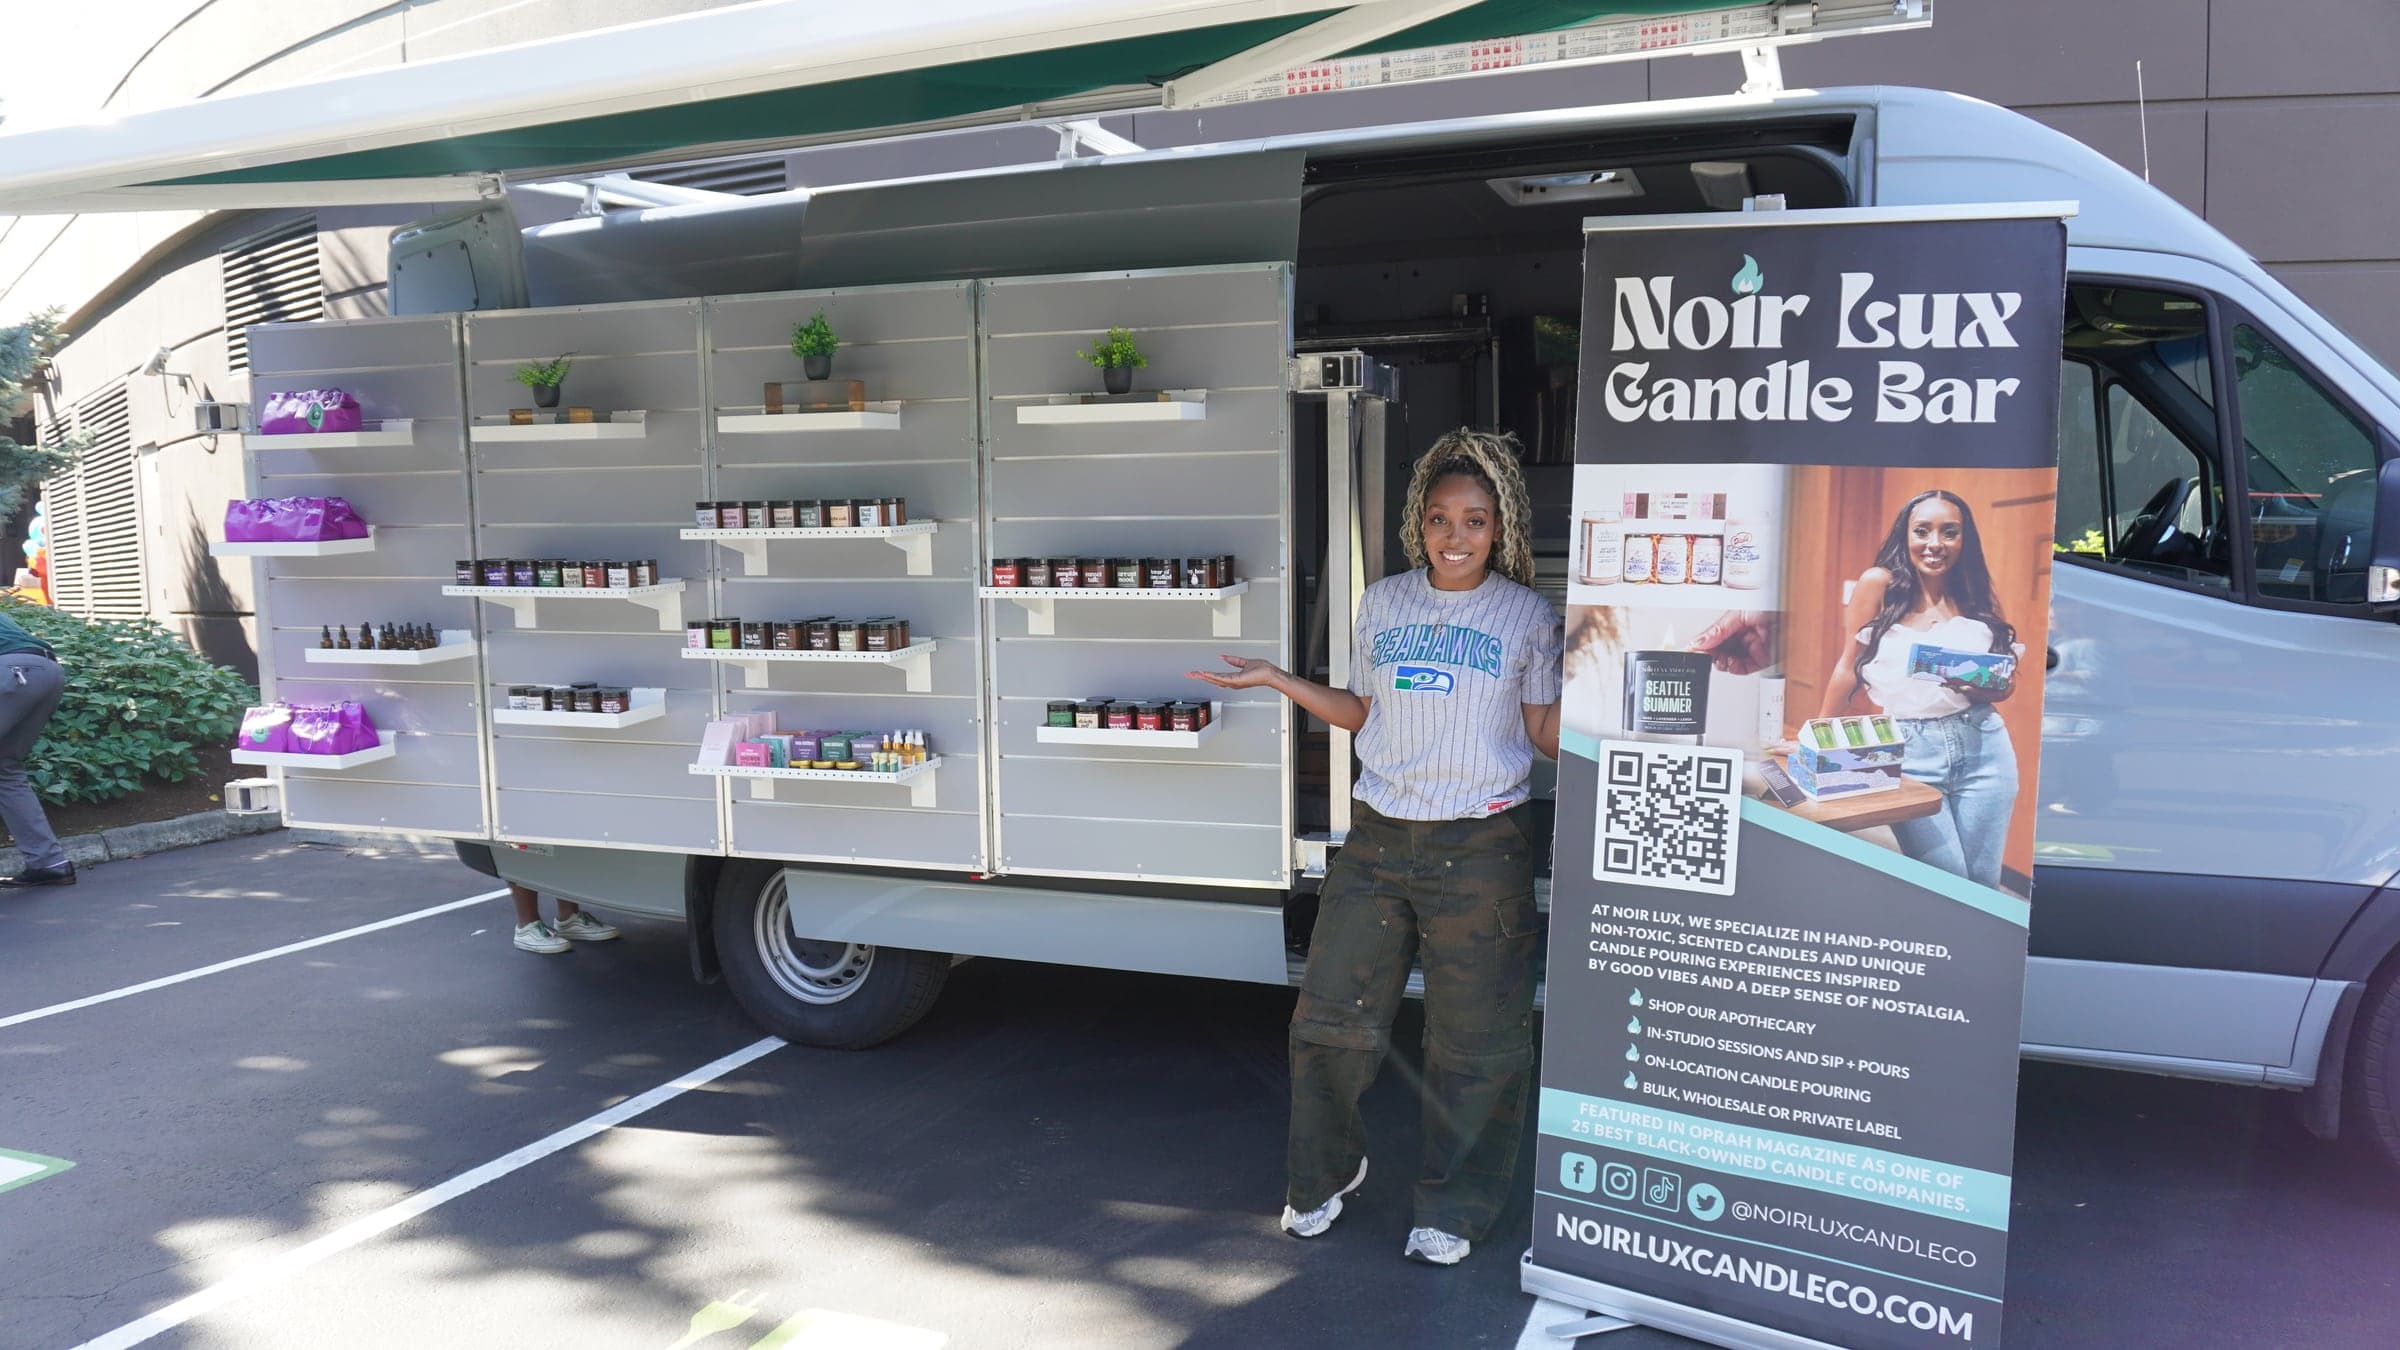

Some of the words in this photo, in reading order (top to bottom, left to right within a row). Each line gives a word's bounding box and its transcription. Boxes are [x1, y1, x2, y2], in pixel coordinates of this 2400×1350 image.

[1610, 276, 1810, 351] Noir
[1836, 272, 2022, 350] Lux
[1605, 359, 1853, 422] Candle
[1875, 361, 2021, 424] Bar
[1372, 624, 1502, 679] SEAHAWKS
[1643, 697, 1692, 713] SUMMER
[1646, 680, 1692, 696] SEATTLE
[1590, 921, 1676, 945] NON-TOXIC,
[1678, 933, 1744, 953] SCENTED
[1746, 943, 1818, 963] CANDLES
[1821, 952, 1858, 967] AND
[1861, 956, 1926, 976] UNIQUE
[1591, 903, 1610, 916] AT
[1612, 906, 1649, 922] NOIR
[1652, 910, 1685, 927] LUX,
[1688, 915, 1712, 930] WE
[1714, 919, 1800, 941] SPECIALIZE
[1803, 930, 1821, 943] IN
[1824, 932, 1952, 961] HAND-POURED,
[1588, 958, 1608, 971] BY
[1610, 961, 1654, 978] GOOD
[1657, 967, 1698, 985] VIBES
[1700, 975, 1734, 990] AND
[1736, 980, 1748, 993] A
[1751, 982, 1791, 998] DEEP
[1793, 988, 1843, 1005] SENSE
[1845, 994, 1869, 1008] OF
[1871, 997, 1970, 1024] NOSTALGIA.
[1589, 940, 1647, 959] CANDLE
[1649, 947, 1716, 969] POURING
[1719, 958, 1822, 983] EXPERIENCES
[1825, 971, 1901, 992] INSPIRED
[1648, 998, 1686, 1014] SHOP
[1686, 1005, 1717, 1021] OUR
[1718, 1010, 1817, 1035] APOTHECARY
[1644, 1054, 1738, 1082] ON-LOCATION
[1740, 1072, 1799, 1092] CANDLE
[1801, 1081, 1871, 1103] POURING
[1647, 1026, 1716, 1049] IN-STUDIO
[1717, 1038, 1783, 1060] SESSIONS
[1784, 1049, 1819, 1065] AND
[1820, 1054, 1844, 1068] SIP
[1858, 1059, 1910, 1080] POURS
[1643, 1081, 1681, 1102] BULK,
[1683, 1089, 1768, 1116] WHOLESALE
[1768, 1105, 1790, 1121] OR
[1792, 1109, 1854, 1131] PRIVATE
[1856, 1119, 1902, 1140] LABEL
[1571, 1119, 1590, 1134] 25
[1594, 1123, 1634, 1143] BEST
[1637, 1131, 1767, 1171] BLACK-OWNED
[1770, 1159, 1847, 1186] CANDLE
[1850, 1174, 1967, 1212] COMPANIES.
[1579, 1101, 1664, 1130] FEATURED
[1667, 1119, 1685, 1136] IN
[1689, 1125, 1754, 1150] OPRAH
[1765, 1140, 1858, 1168] MAGAZINE
[1861, 1156, 1886, 1174] AS
[1890, 1162, 1932, 1184] ONE
[1935, 1172, 1964, 1190] OF
[1731, 1201, 1977, 1268] @NOIRLUXCANDLECO
[1556, 1212, 1973, 1341] NOIRLUXCANDLECO.COM
